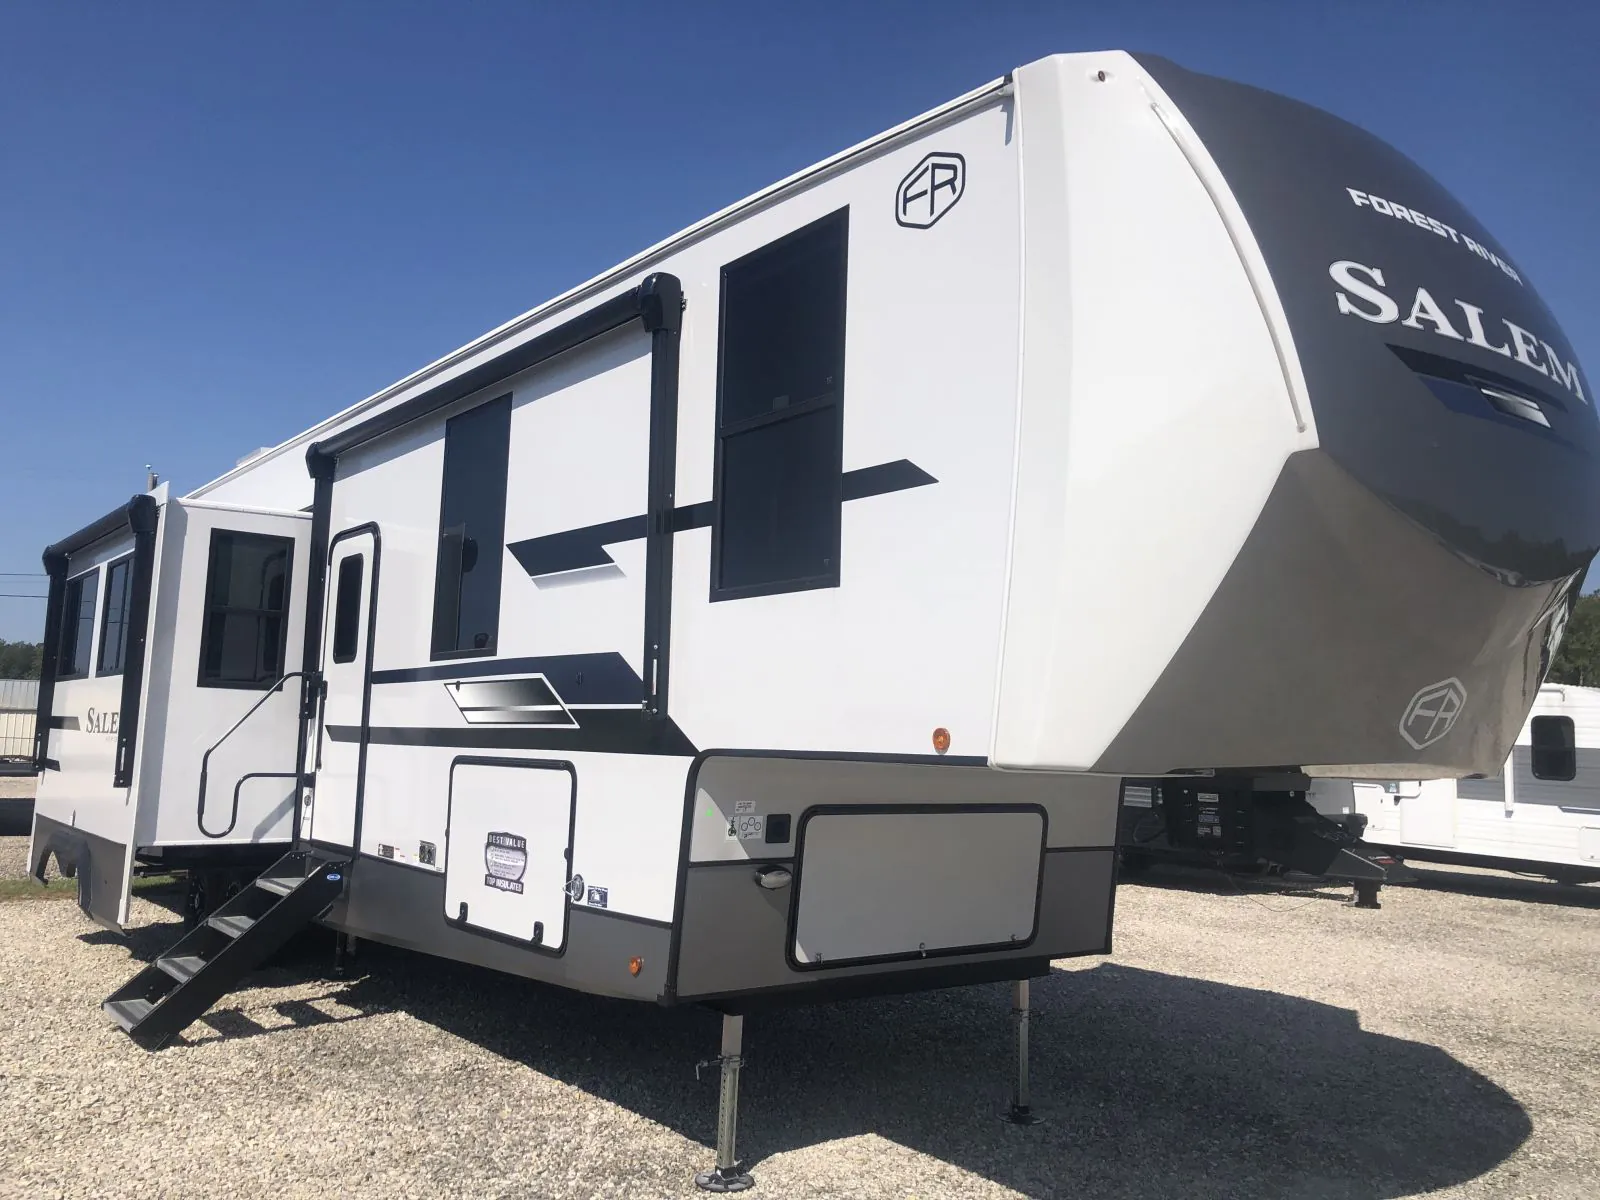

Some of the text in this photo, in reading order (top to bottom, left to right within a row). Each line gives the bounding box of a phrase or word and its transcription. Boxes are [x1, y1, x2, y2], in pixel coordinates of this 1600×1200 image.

[1345, 187, 1524, 287] FOREST RIVER
[1328, 260, 1588, 406] SALEM
[86, 707, 119, 734] SALE
